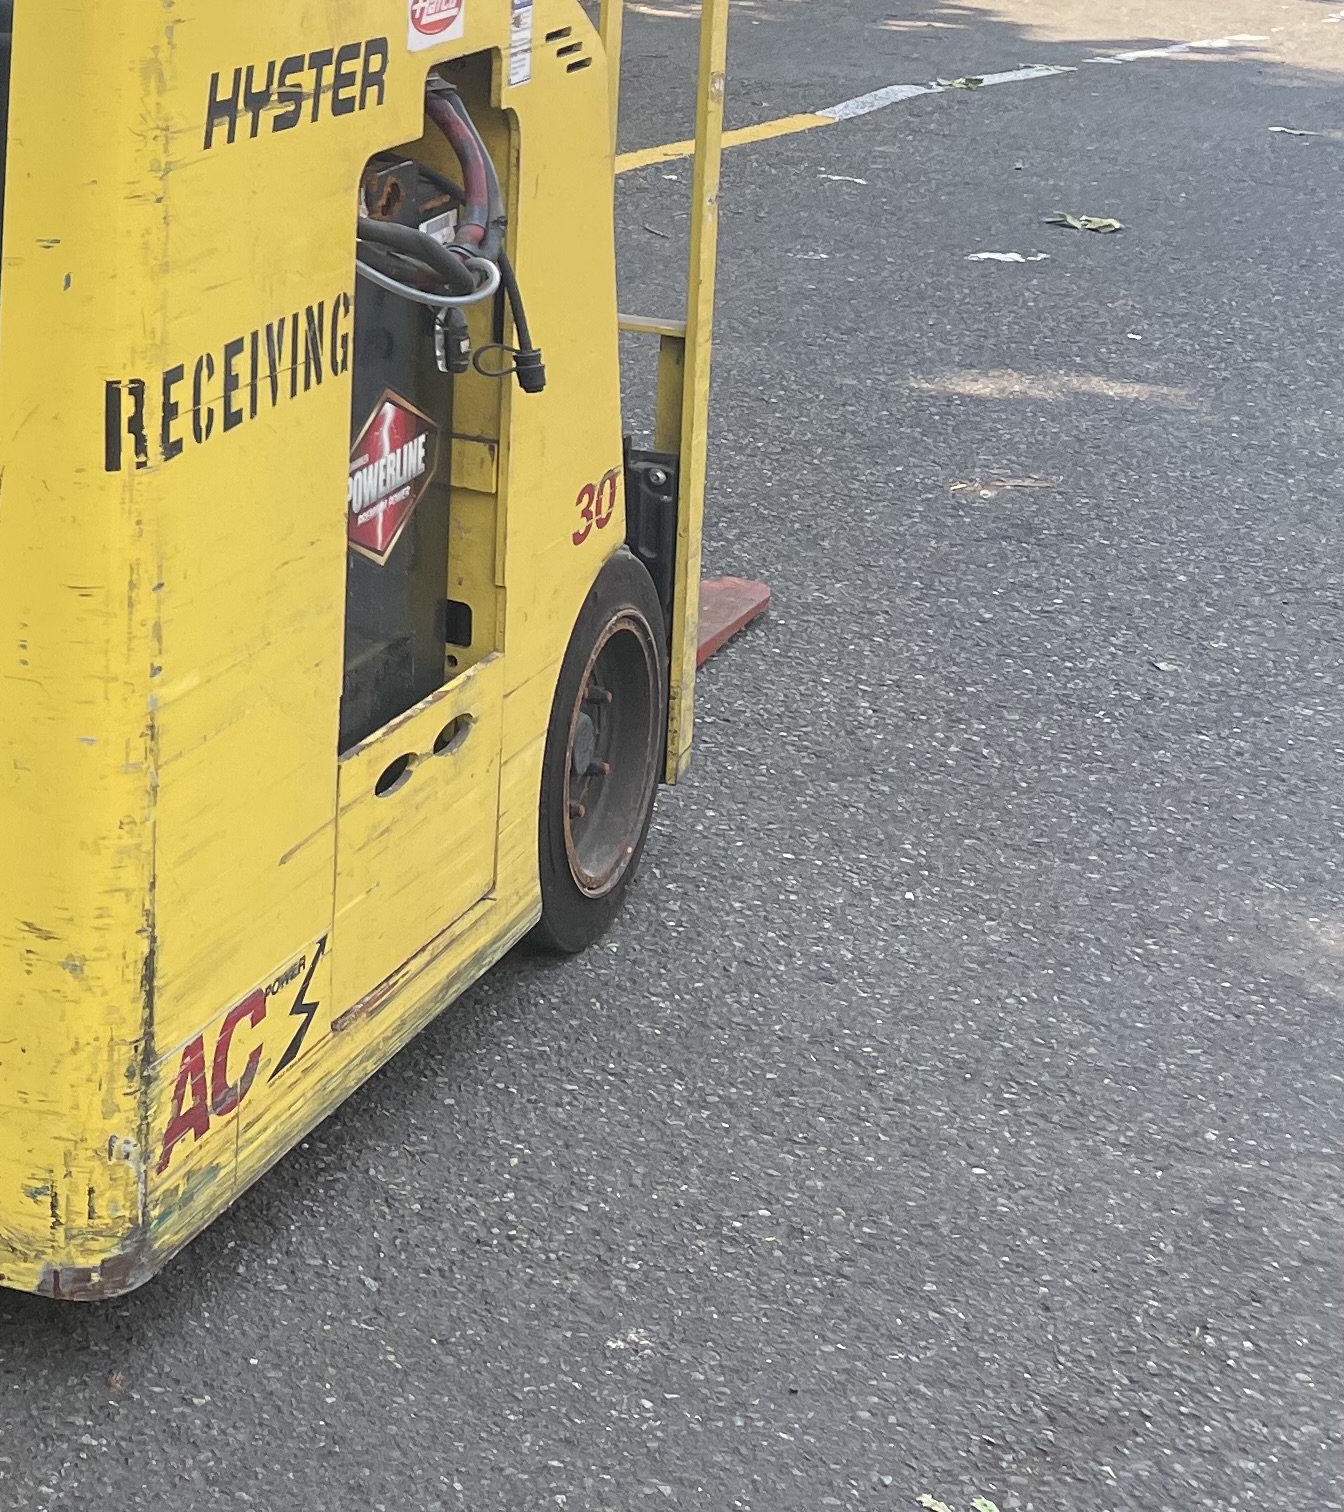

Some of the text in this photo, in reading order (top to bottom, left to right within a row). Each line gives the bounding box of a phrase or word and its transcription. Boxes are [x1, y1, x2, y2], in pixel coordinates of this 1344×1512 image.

[203, 37, 389, 150] HYSTER
[104, 291, 350, 472] RECEIVING
[572, 467, 616, 546] 30
[155, 987, 267, 1176] AC
